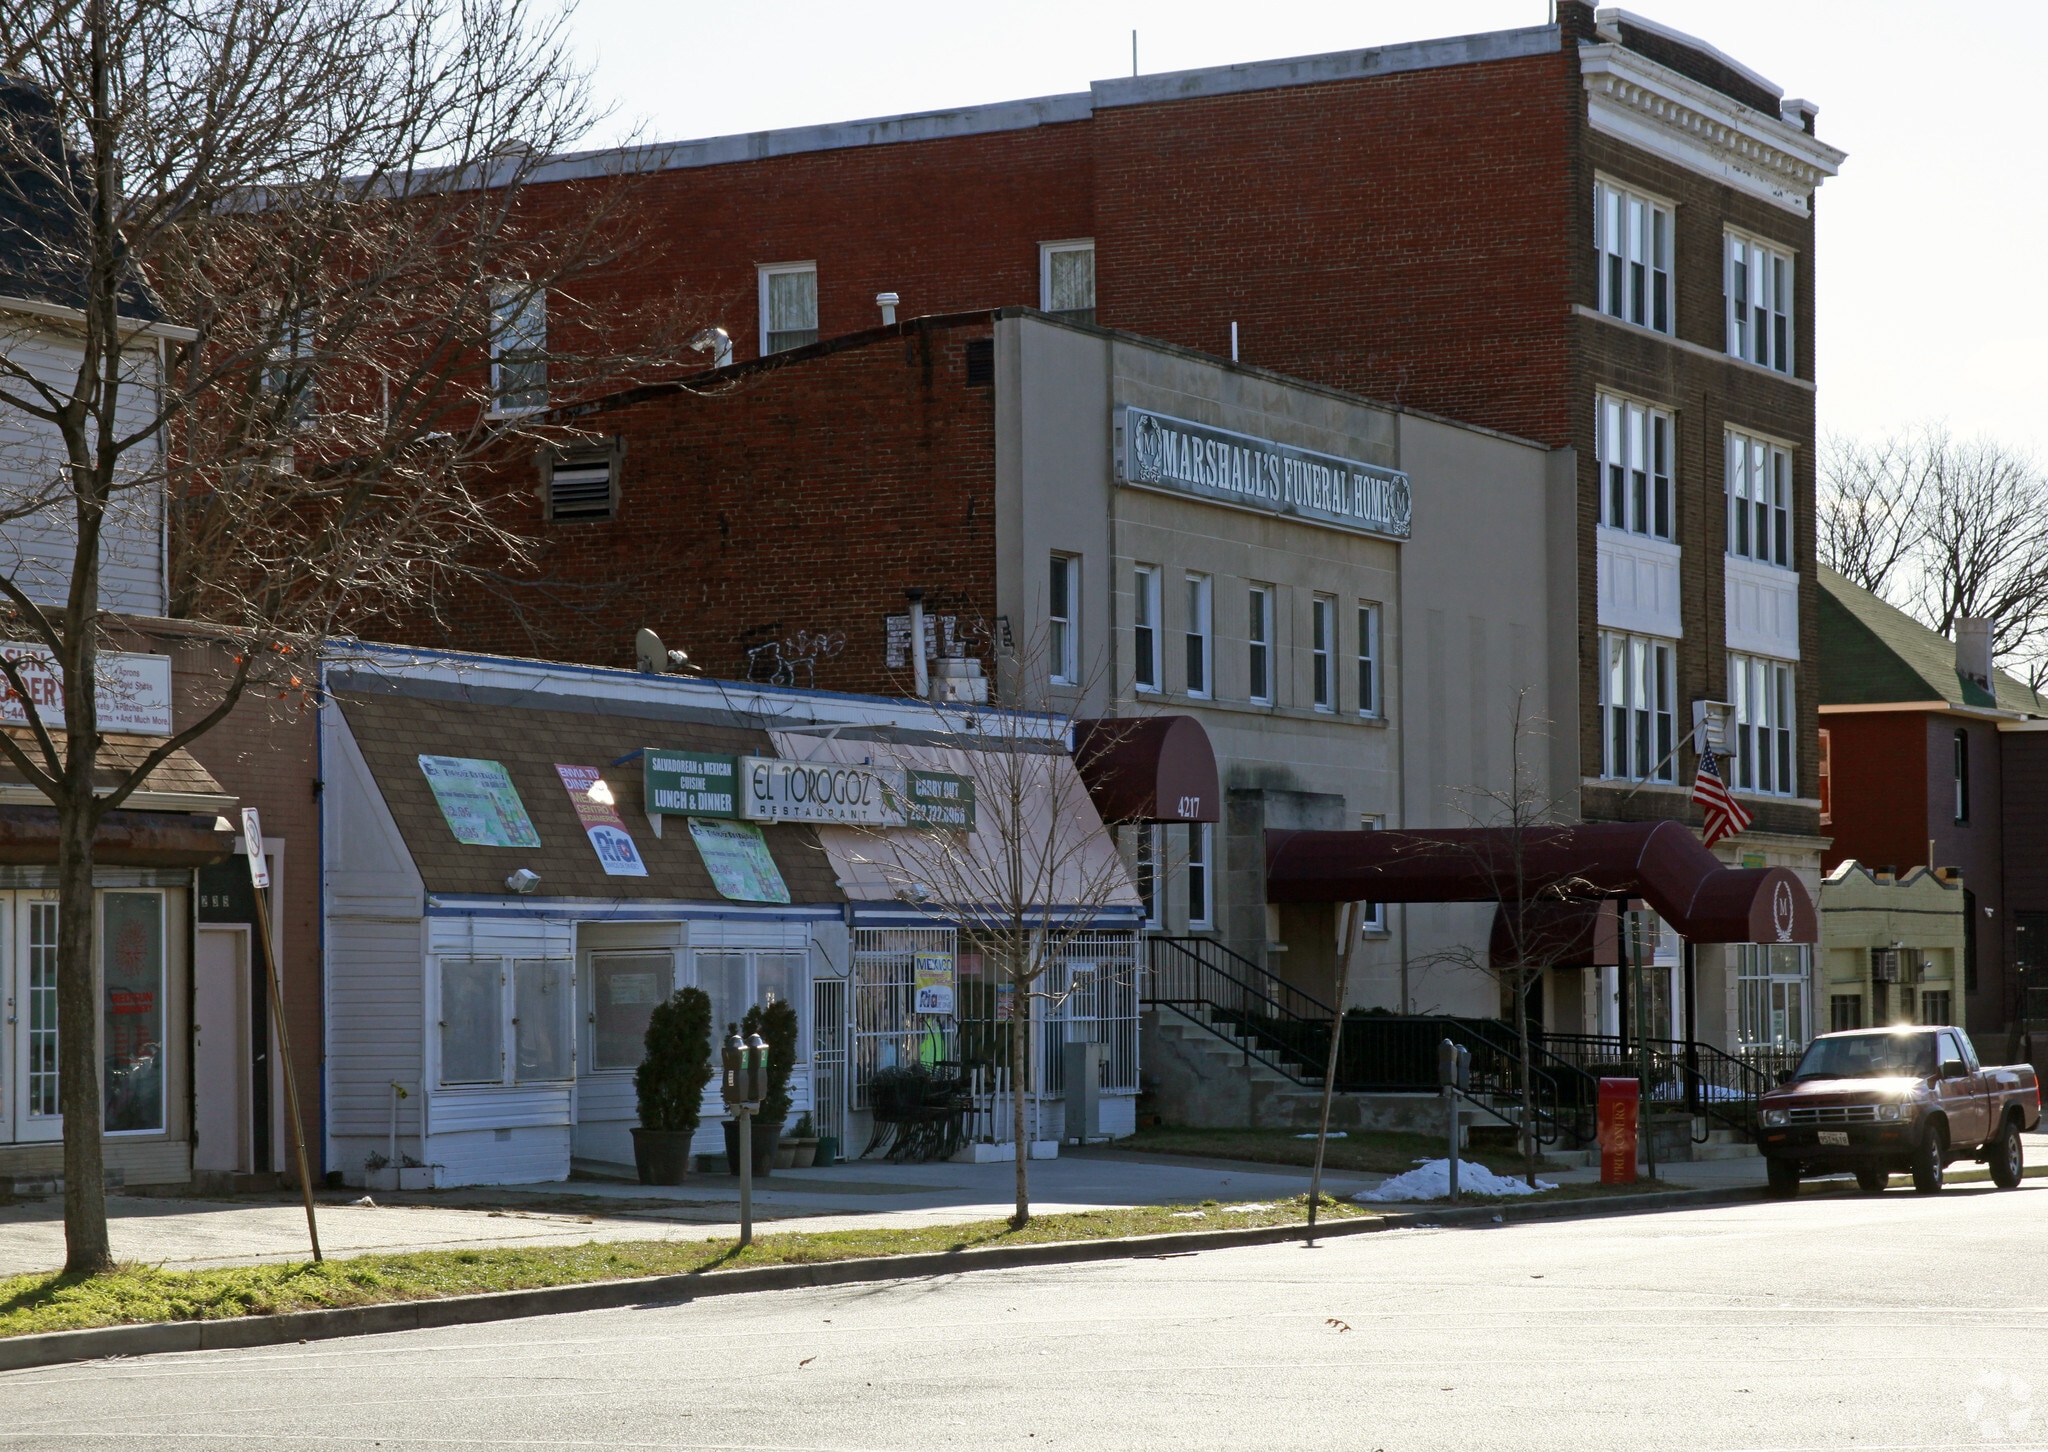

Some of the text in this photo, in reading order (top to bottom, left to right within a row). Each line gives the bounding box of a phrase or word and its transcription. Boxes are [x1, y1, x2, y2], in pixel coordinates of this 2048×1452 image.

[1144, 432, 1155, 456] M
[1161, 428, 1391, 524] MARSHALL'S FUNERAL HOME
[1396, 491, 1406, 512] M
[5, 648, 46, 672] SUN
[120, 714, 133, 722] And
[134, 715, 151, 723] Much
[559, 767, 600, 780] ENVIA TU
[652, 757, 698, 774] SALVADOREAN
[704, 762, 732, 777] MEXICAN
[680, 776, 706, 791] CUISINE
[753, 764, 871, 806] EL TOROGOZ
[915, 779, 960, 799] CARRY OUT
[576, 804, 609, 815] CENTRO
[655, 789, 732, 812] LUNCH & DINNER
[1177, 796, 1200, 818] 4217
[760, 805, 868, 819] RESTAURANT
[593, 830, 637, 863] Ria
[1779, 897, 1788, 916] M
[916, 958, 953, 971] MEXICO
[919, 989, 938, 1008] Ria
